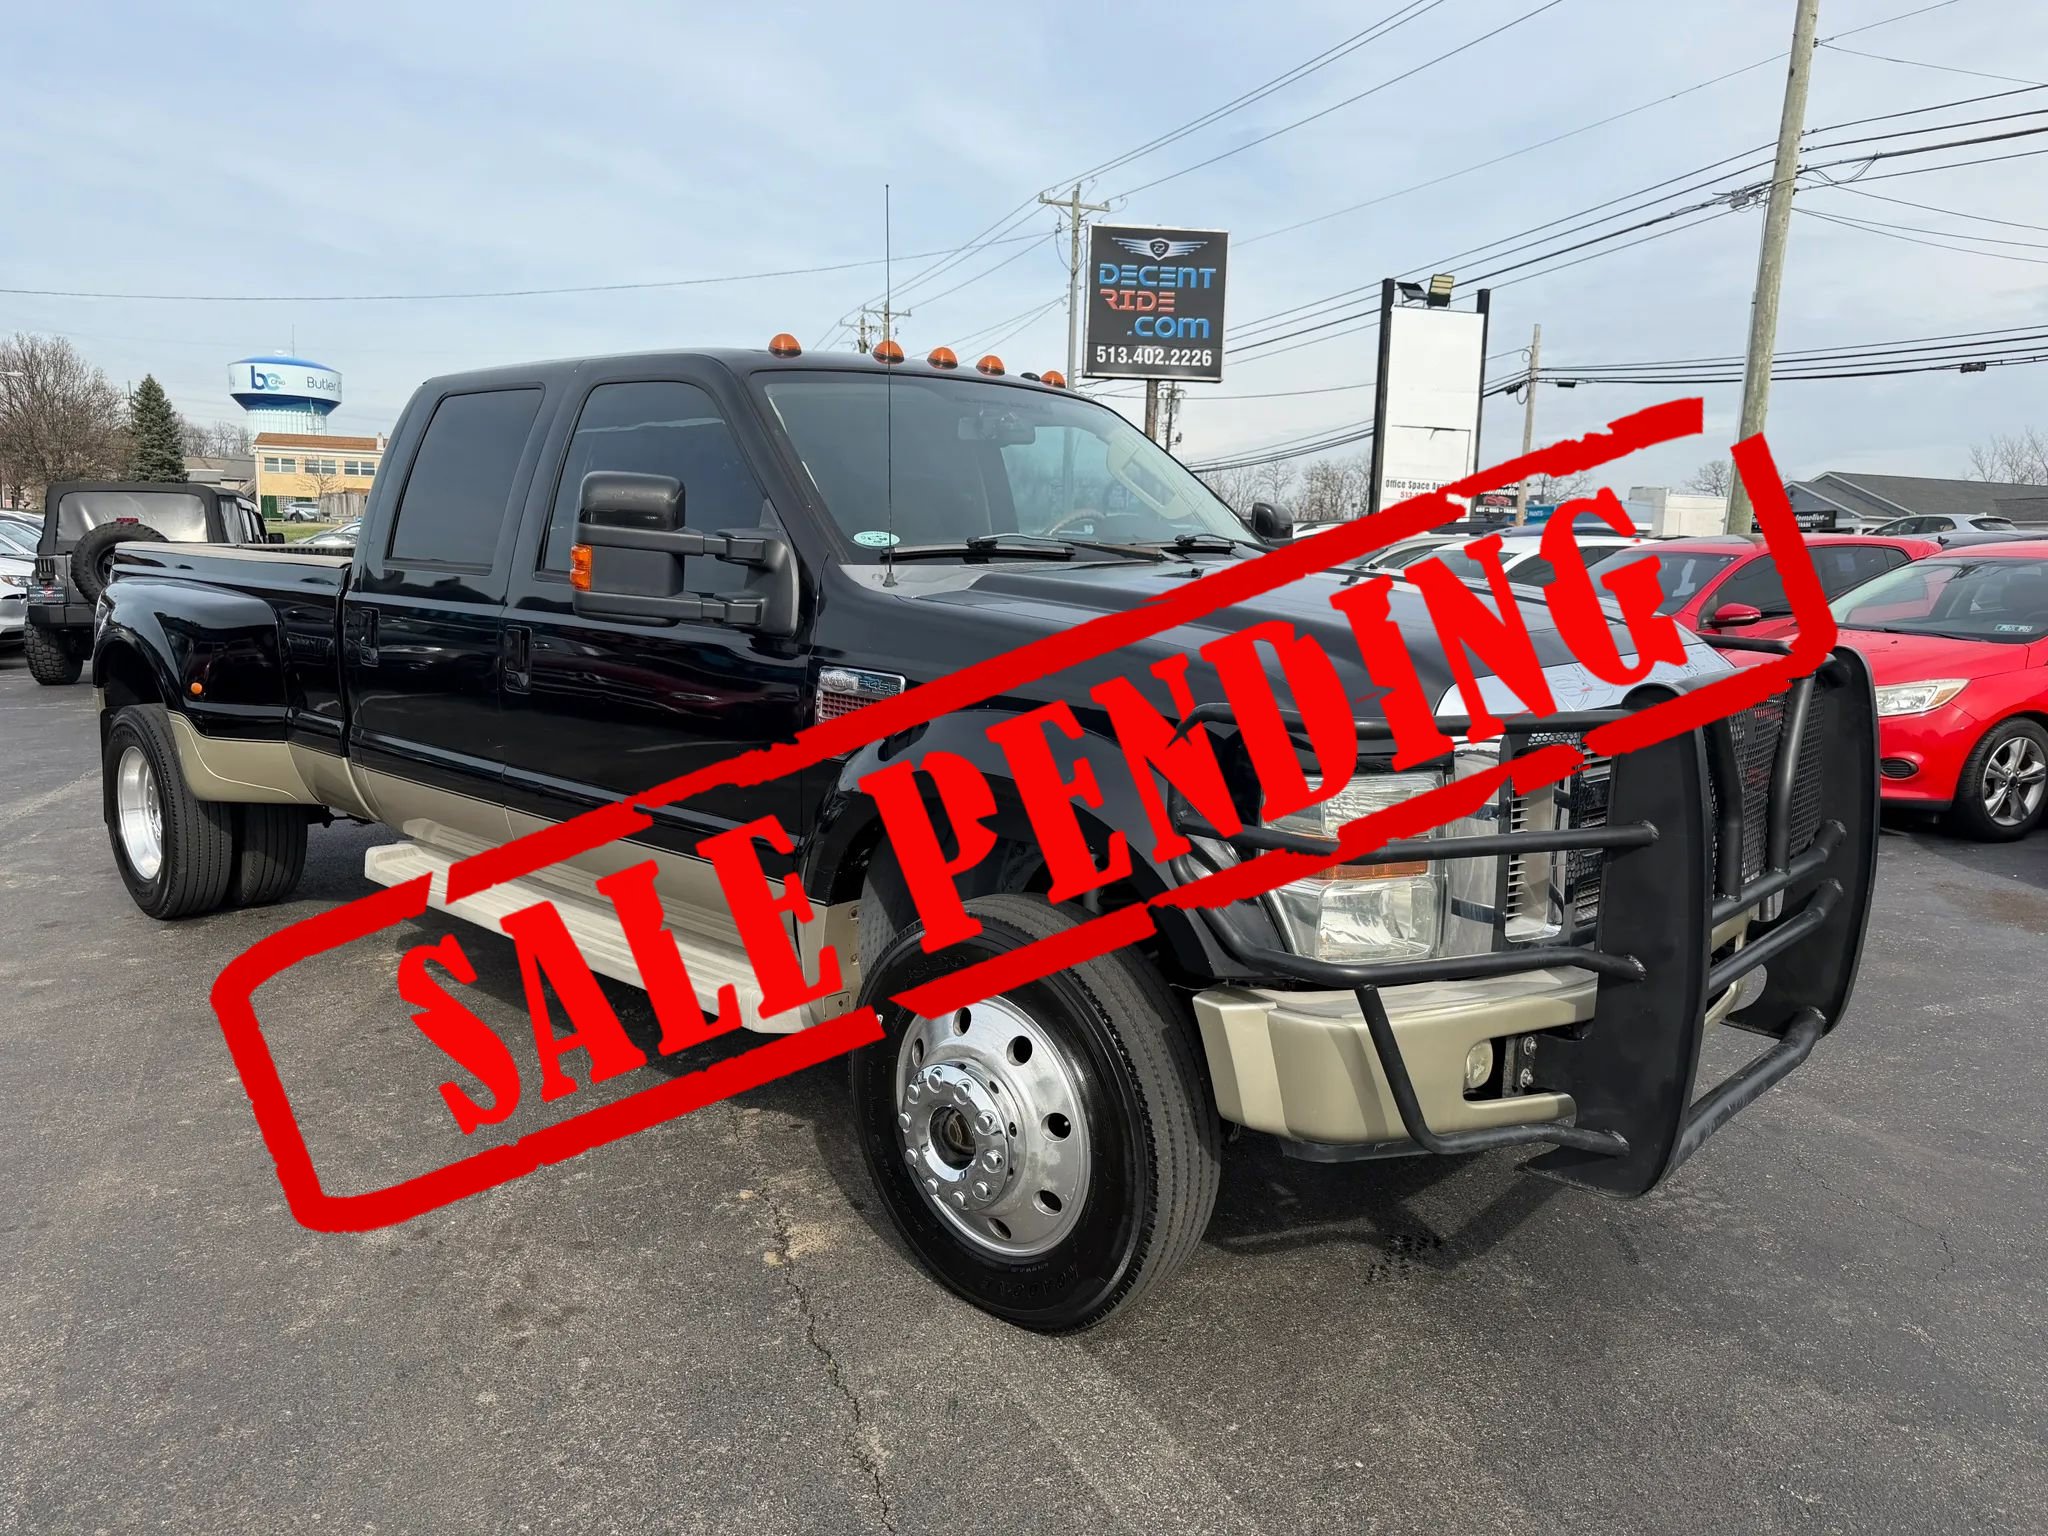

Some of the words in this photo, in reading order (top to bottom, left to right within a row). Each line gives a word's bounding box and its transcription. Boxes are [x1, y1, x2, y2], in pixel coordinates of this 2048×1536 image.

[1098, 263, 1217, 289] DECENT
[1099, 288, 1176, 313] RIDE
[1096, 345, 1213, 367] 513.402.2226
[306, 376, 337, 392] Butler
[1385, 479, 1406, 489] Office
[1407, 480, 1431, 492] Space
